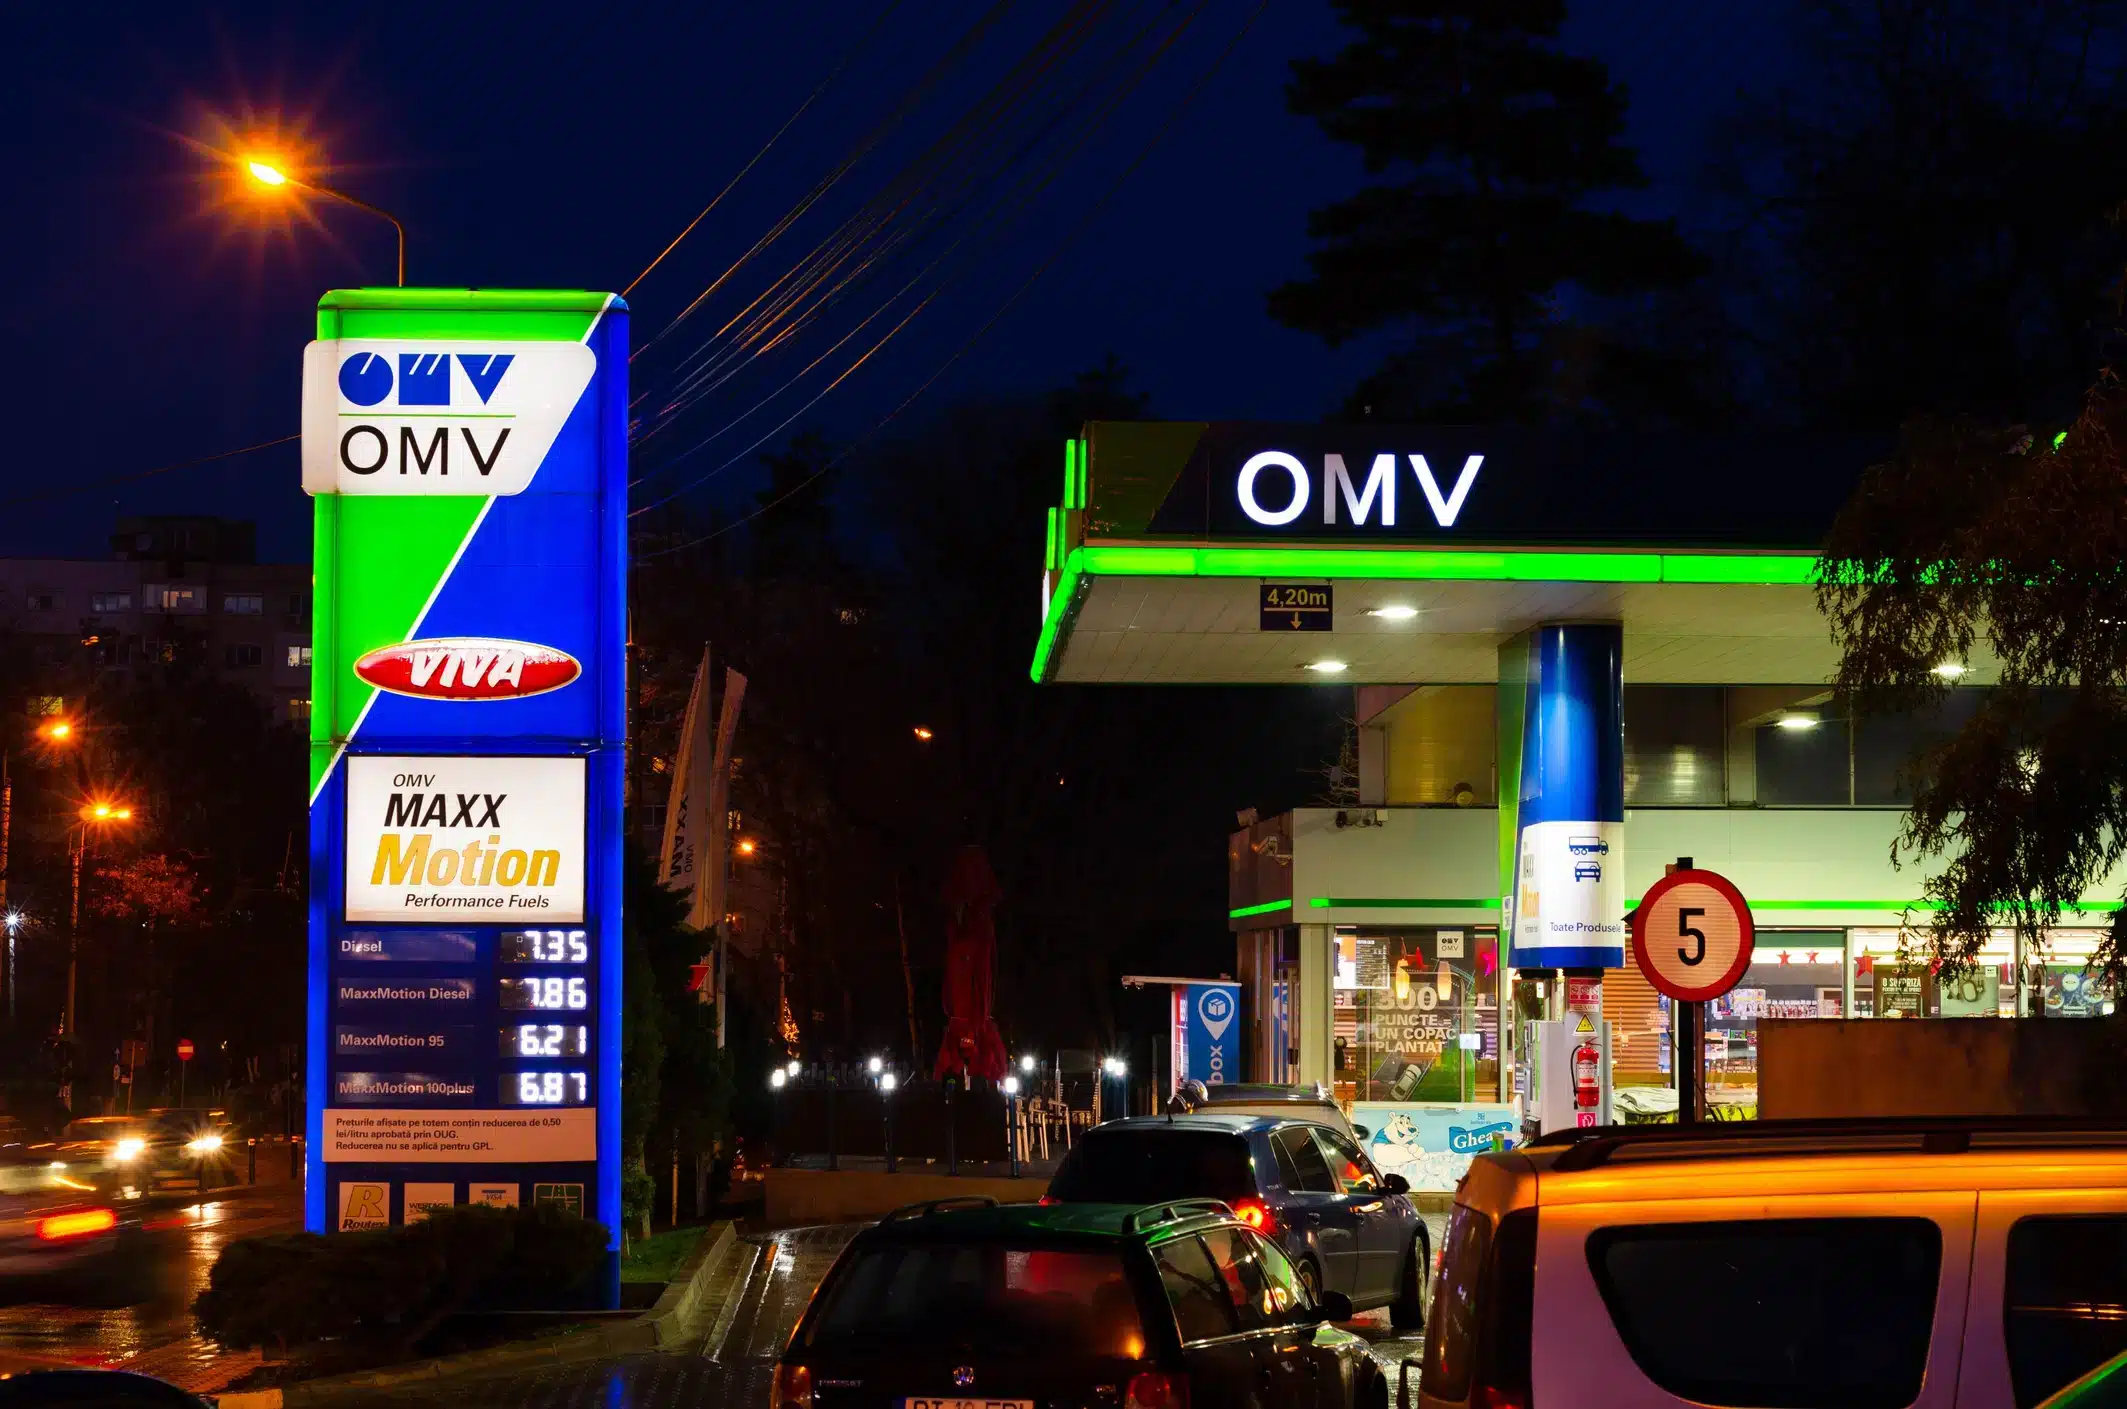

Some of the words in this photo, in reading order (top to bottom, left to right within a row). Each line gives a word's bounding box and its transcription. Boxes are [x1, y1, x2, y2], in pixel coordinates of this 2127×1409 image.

[340, 425, 511, 476] OMV
[1237, 451, 1485, 527] OMV
[1267, 589, 1327, 607] 4,20m
[409, 649, 525, 688] VIVA
[393, 774, 435, 787] OMV
[384, 794, 507, 828] MAXX
[370, 834, 561, 887] Motion
[405, 894, 503, 908] Performance
[508, 895, 549, 908] Fuels
[1550, 922, 1574, 932] Toate
[1576, 922, 1621, 933] Produsele
[1677, 908, 1705, 966] 5
[341, 940, 382, 952] Diesel
[524, 930, 587, 961] 7.35
[341, 988, 426, 1000] MaxxMotion
[429, 988, 470, 1000] Diesel
[524, 977, 587, 1008] 7.86
[1376, 1014, 1438, 1026] PUNCTE
[340, 1034, 425, 1046] MaxxMotion
[428, 1035, 444, 1047] 95
[520, 1025, 587, 1055] 6.21
[1376, 1027, 1398, 1039] UN
[1403, 1027, 1457, 1040] COPAC
[1375, 1041, 1446, 1053] PLANTAT
[1206, 1044, 1224, 1086] box
[339, 1082, 425, 1095] MaxxMotion
[520, 1072, 587, 1103] 6.87
[408, 1119, 420, 1129] pe
[422, 1118, 450, 1127] totem
[482, 1118, 527, 1127] reducerea
[529, 1118, 540, 1127] de
[542, 1118, 561, 1128] 0,50
[336, 1129, 369, 1139] lei/litru
[370, 1130, 411, 1141] aprobată
[413, 1130, 432, 1141] prin
[433, 1130, 459, 1139] OUG.
[336, 1142, 384, 1150] Reducerea
[411, 1142, 439, 1152] aplică
[440, 1142, 471, 1152] pentru
[472, 1142, 494, 1151] GPL.
